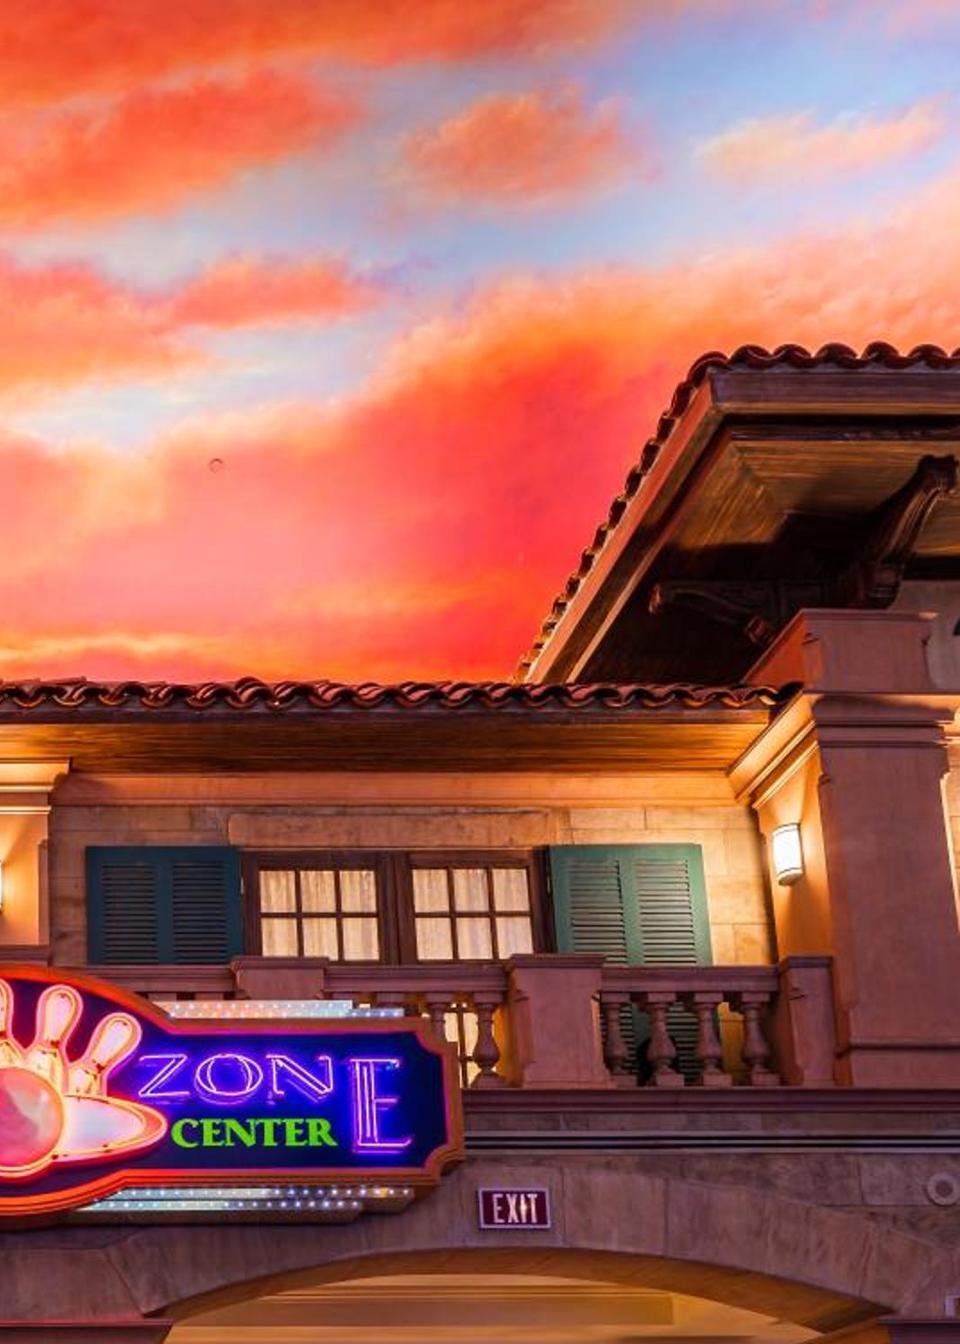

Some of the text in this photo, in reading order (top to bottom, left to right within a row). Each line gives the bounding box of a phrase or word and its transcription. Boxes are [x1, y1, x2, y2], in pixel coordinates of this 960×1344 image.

[137, 1052, 414, 1153] ZONE
[171, 1117, 338, 1148] CENTER
[492, 1193, 538, 1224] EXIT
